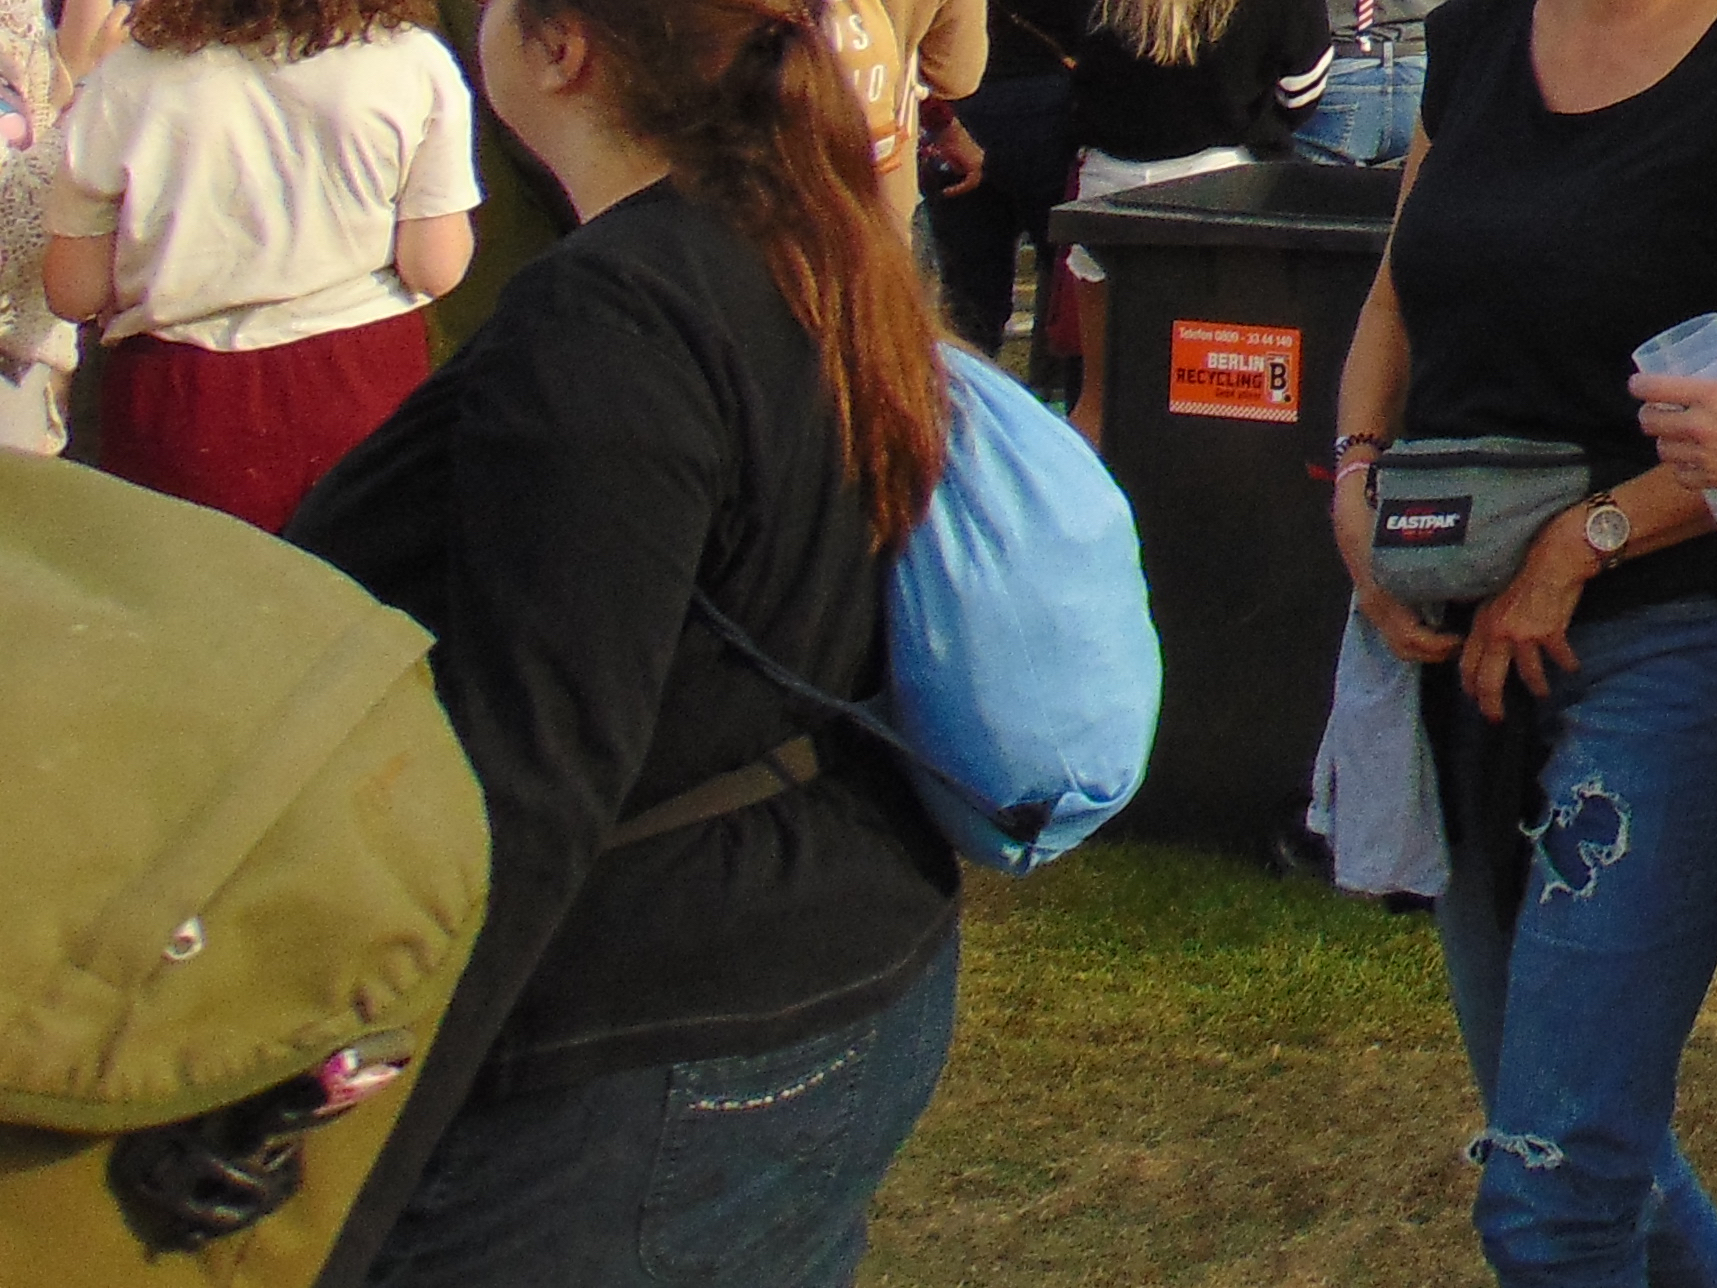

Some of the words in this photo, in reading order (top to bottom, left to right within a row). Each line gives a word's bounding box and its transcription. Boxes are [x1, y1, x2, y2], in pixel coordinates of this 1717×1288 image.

[1208, 352, 1265, 373] BERLIN
[1176, 368, 1264, 389] RECYCLING
[1386, 512, 1457, 530] EASTPAK
